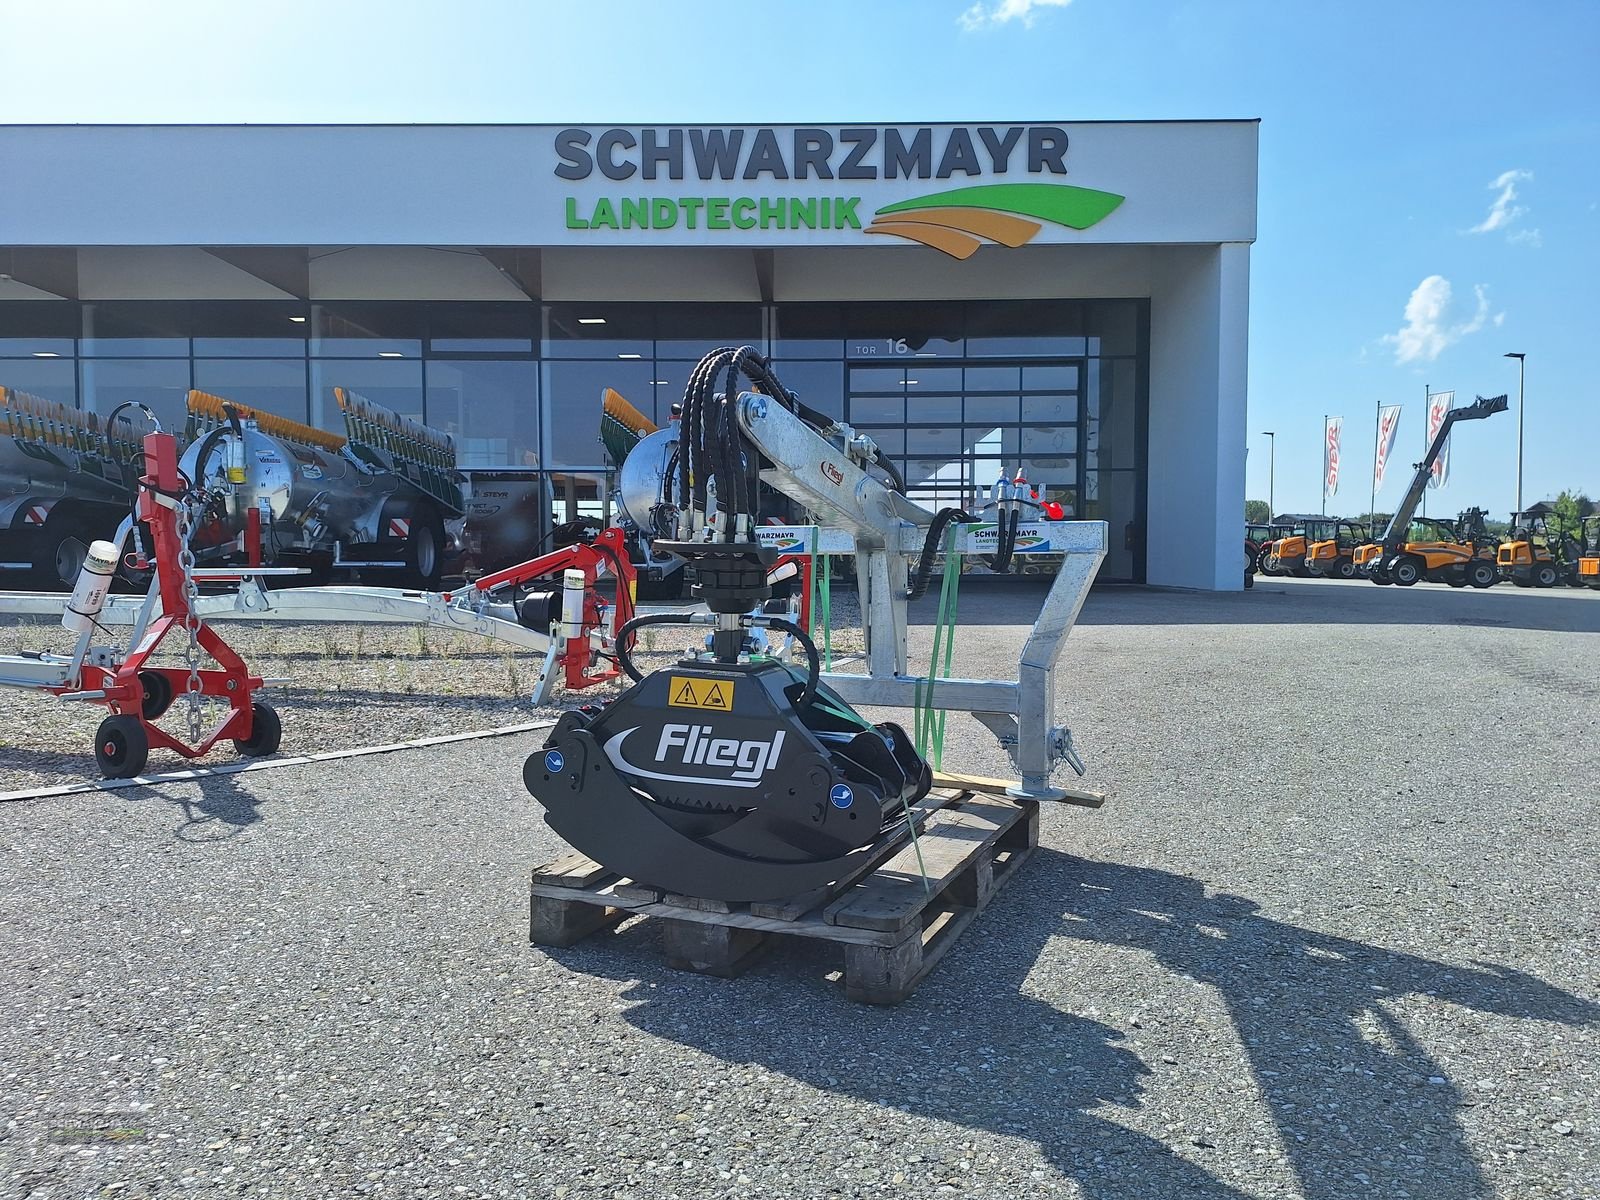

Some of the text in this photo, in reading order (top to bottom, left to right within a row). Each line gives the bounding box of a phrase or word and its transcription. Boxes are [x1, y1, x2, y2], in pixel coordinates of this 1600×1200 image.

[554, 126, 1069, 181] SCHWARZMAYR
[565, 196, 863, 230] LANDTECHNIK
[855, 338, 908, 354] TOR 16
[1327, 426, 1338, 486] STEYR
[974, 530, 1038, 538] SCHWRMAYR
[654, 723, 787, 780] Fliegl
